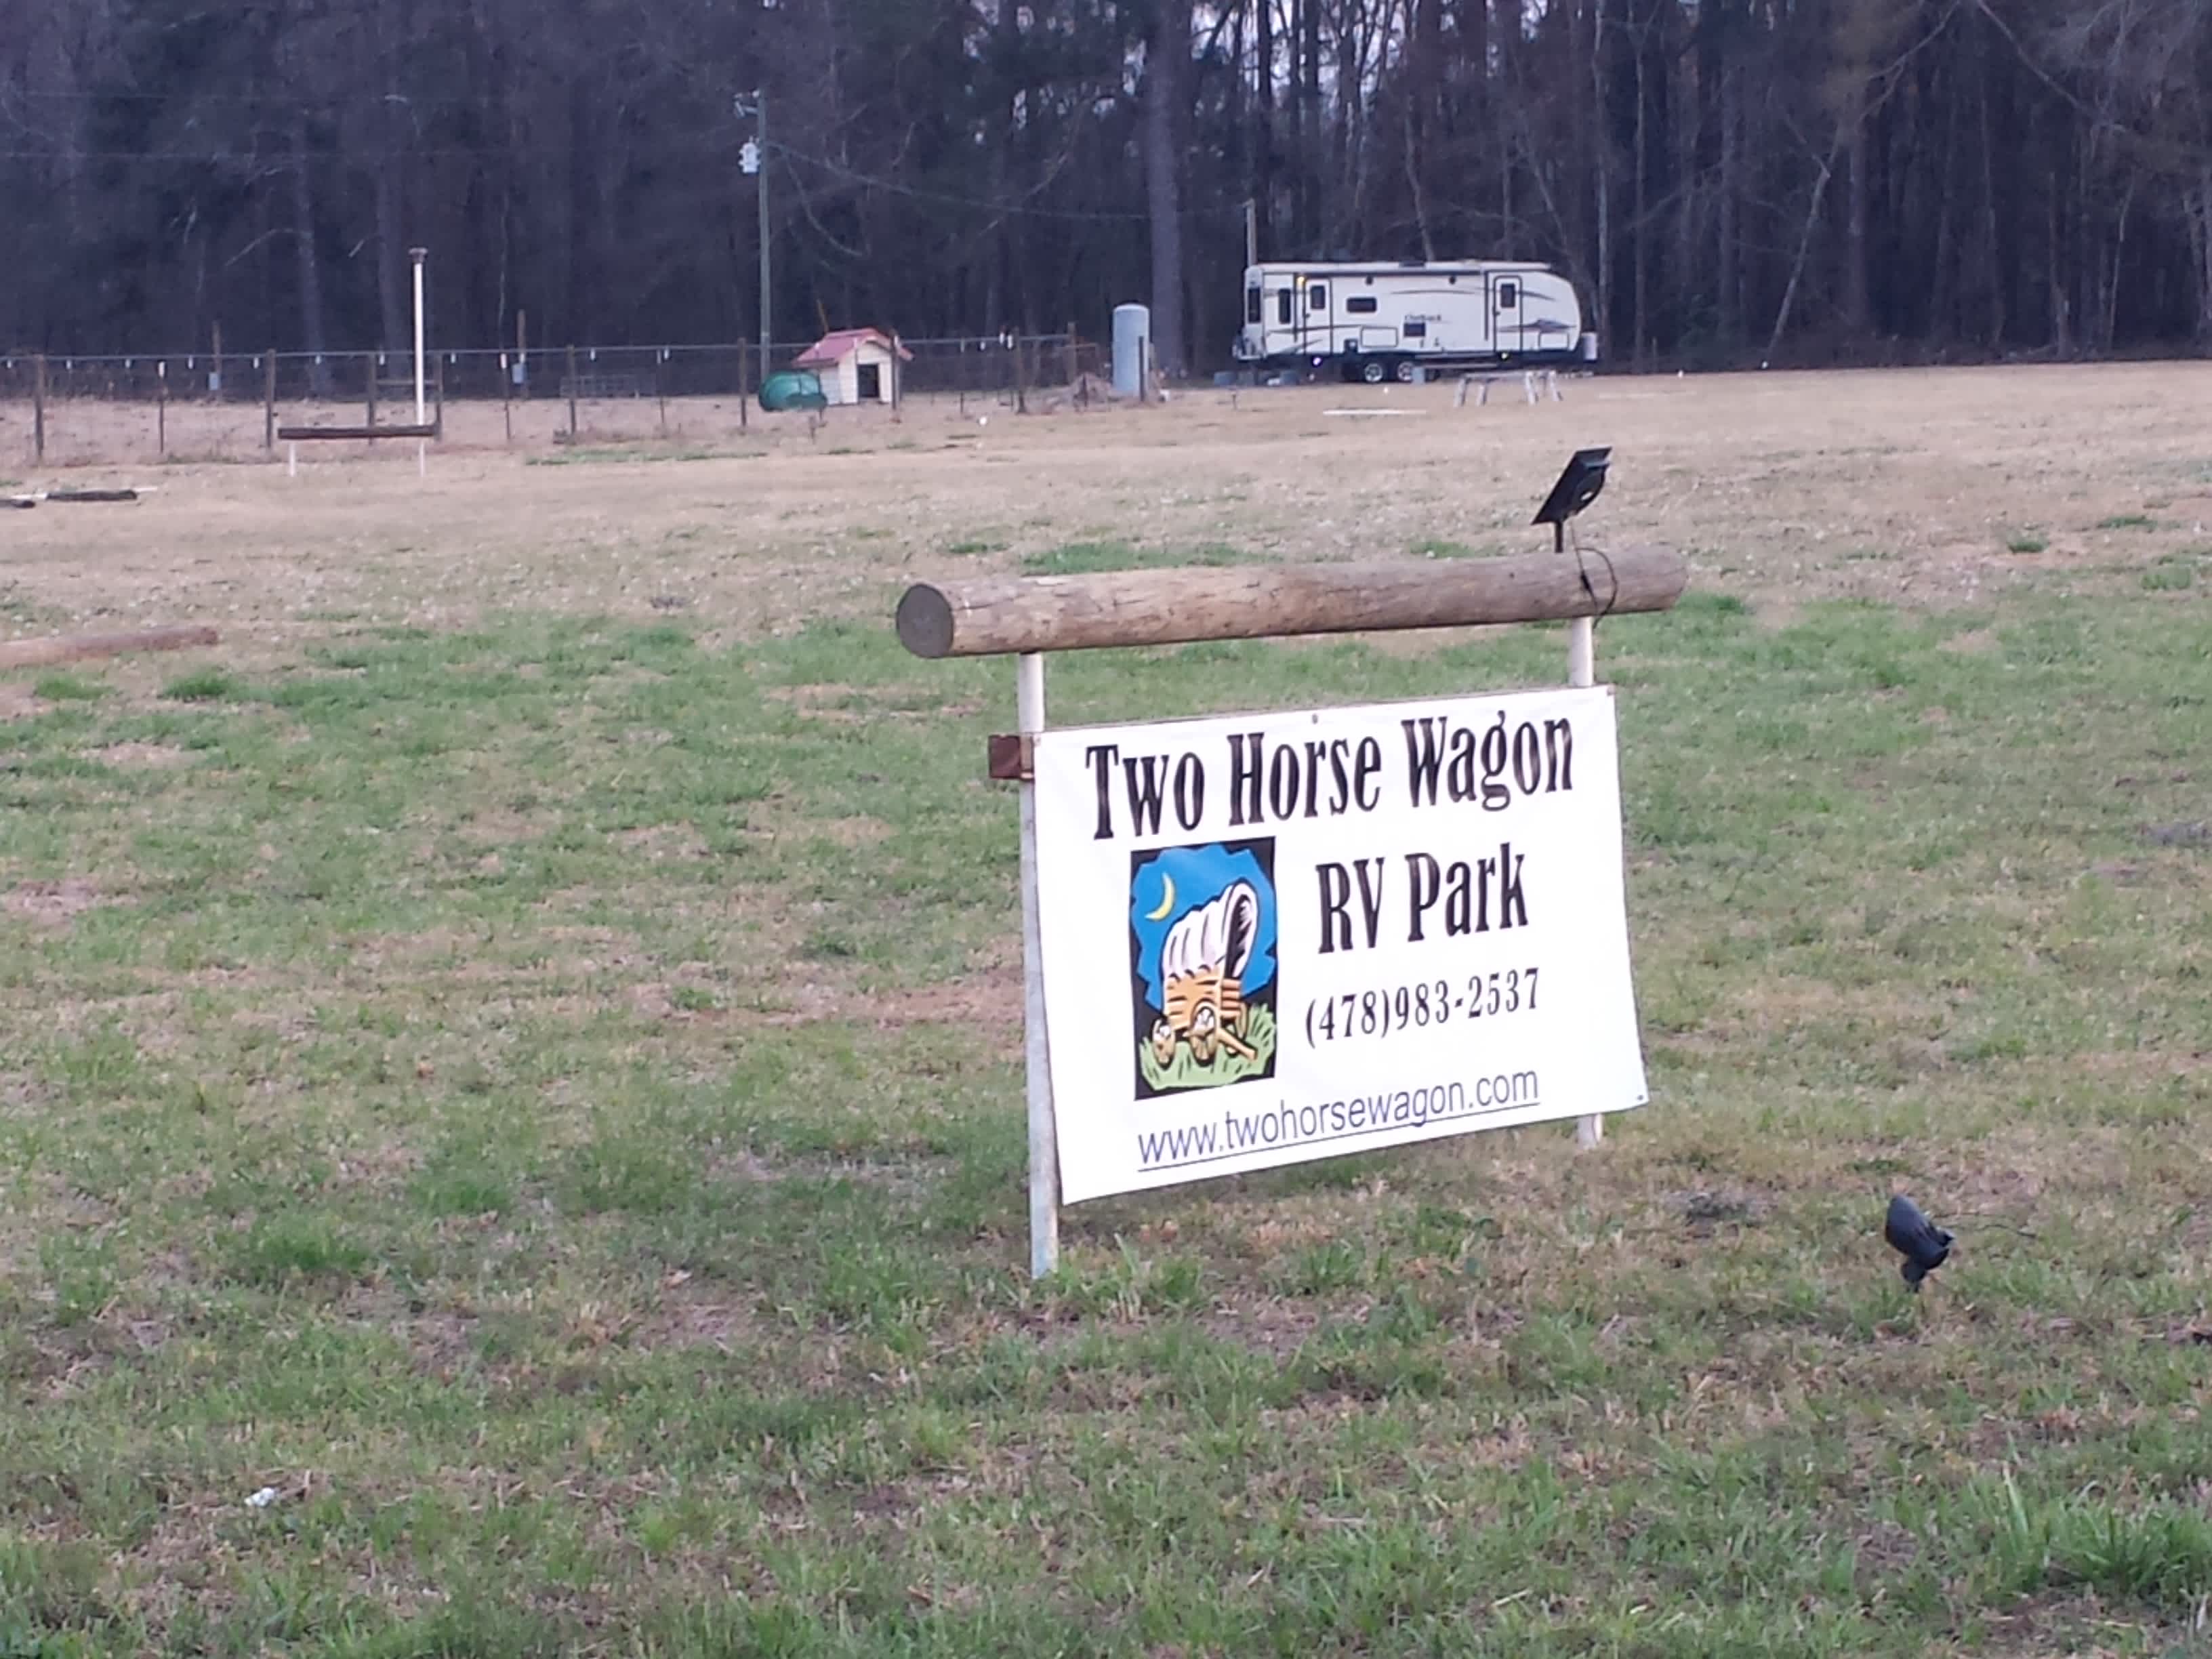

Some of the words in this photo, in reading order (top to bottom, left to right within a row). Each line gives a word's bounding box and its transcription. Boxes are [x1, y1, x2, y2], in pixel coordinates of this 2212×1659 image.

[1086, 744, 1205, 840] Two
[1227, 732, 1381, 825] Horse
[1401, 710, 1572, 811] Wagon
[1315, 857, 1385, 954] RV
[1405, 842, 1528, 941] Park
[1306, 968, 1539, 1047] (478)983-2537
[1139, 1069, 1538, 1164] www.twohorsewagon.com
